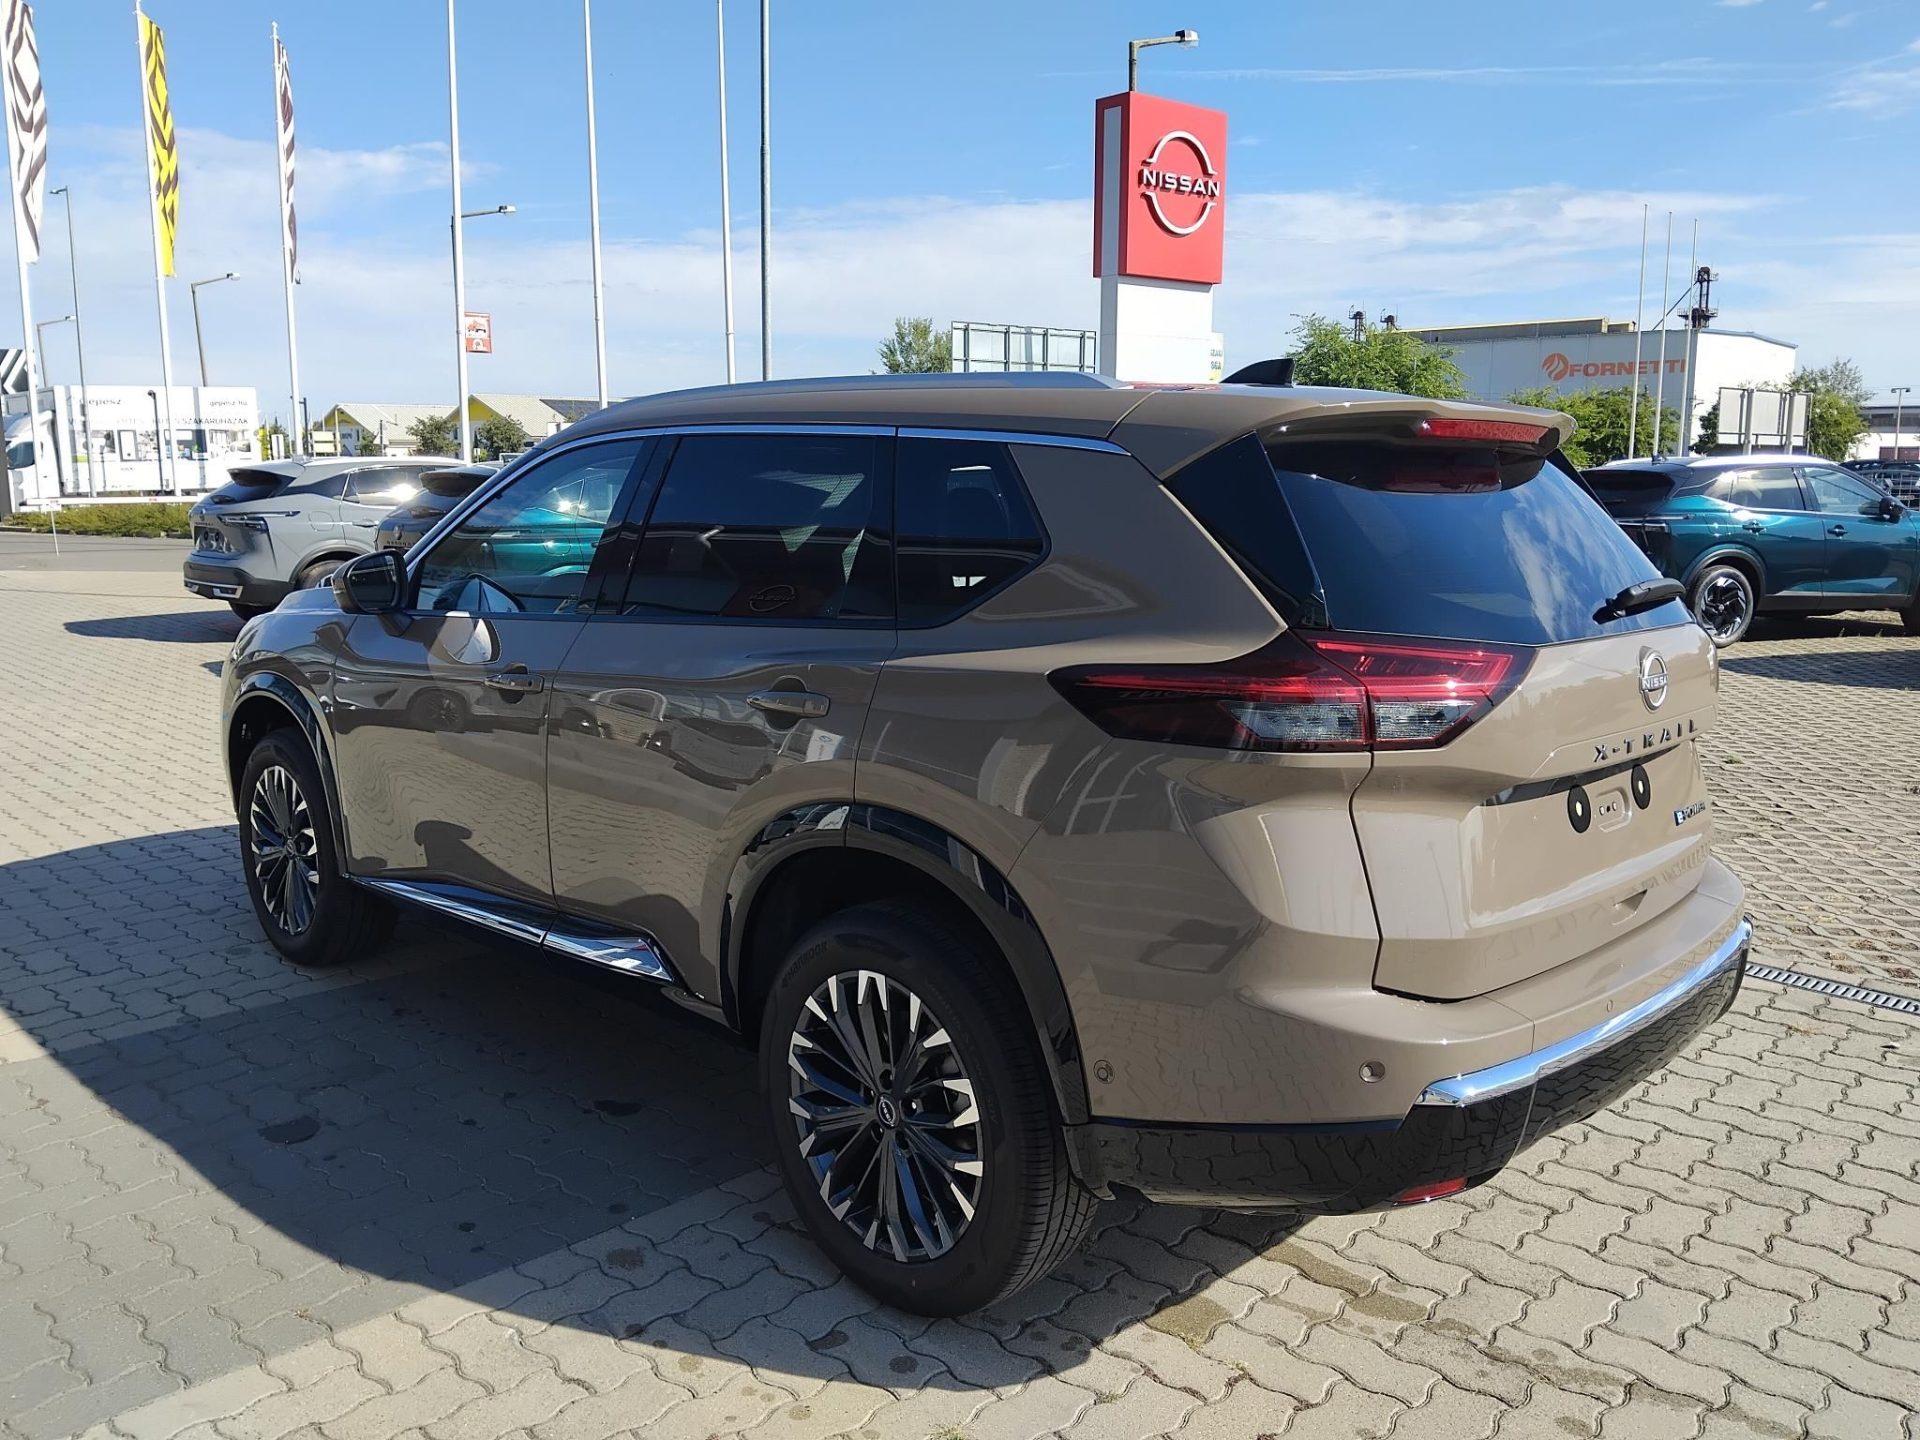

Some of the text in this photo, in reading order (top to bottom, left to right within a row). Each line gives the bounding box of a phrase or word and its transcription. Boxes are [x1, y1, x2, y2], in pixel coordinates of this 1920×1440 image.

[1143, 168, 1220, 197] NISSAN
[1569, 359, 1686, 378] FORNETTI
[1642, 675, 1668, 690] NISSA
[1593, 719, 1698, 763] X-TRAIL
